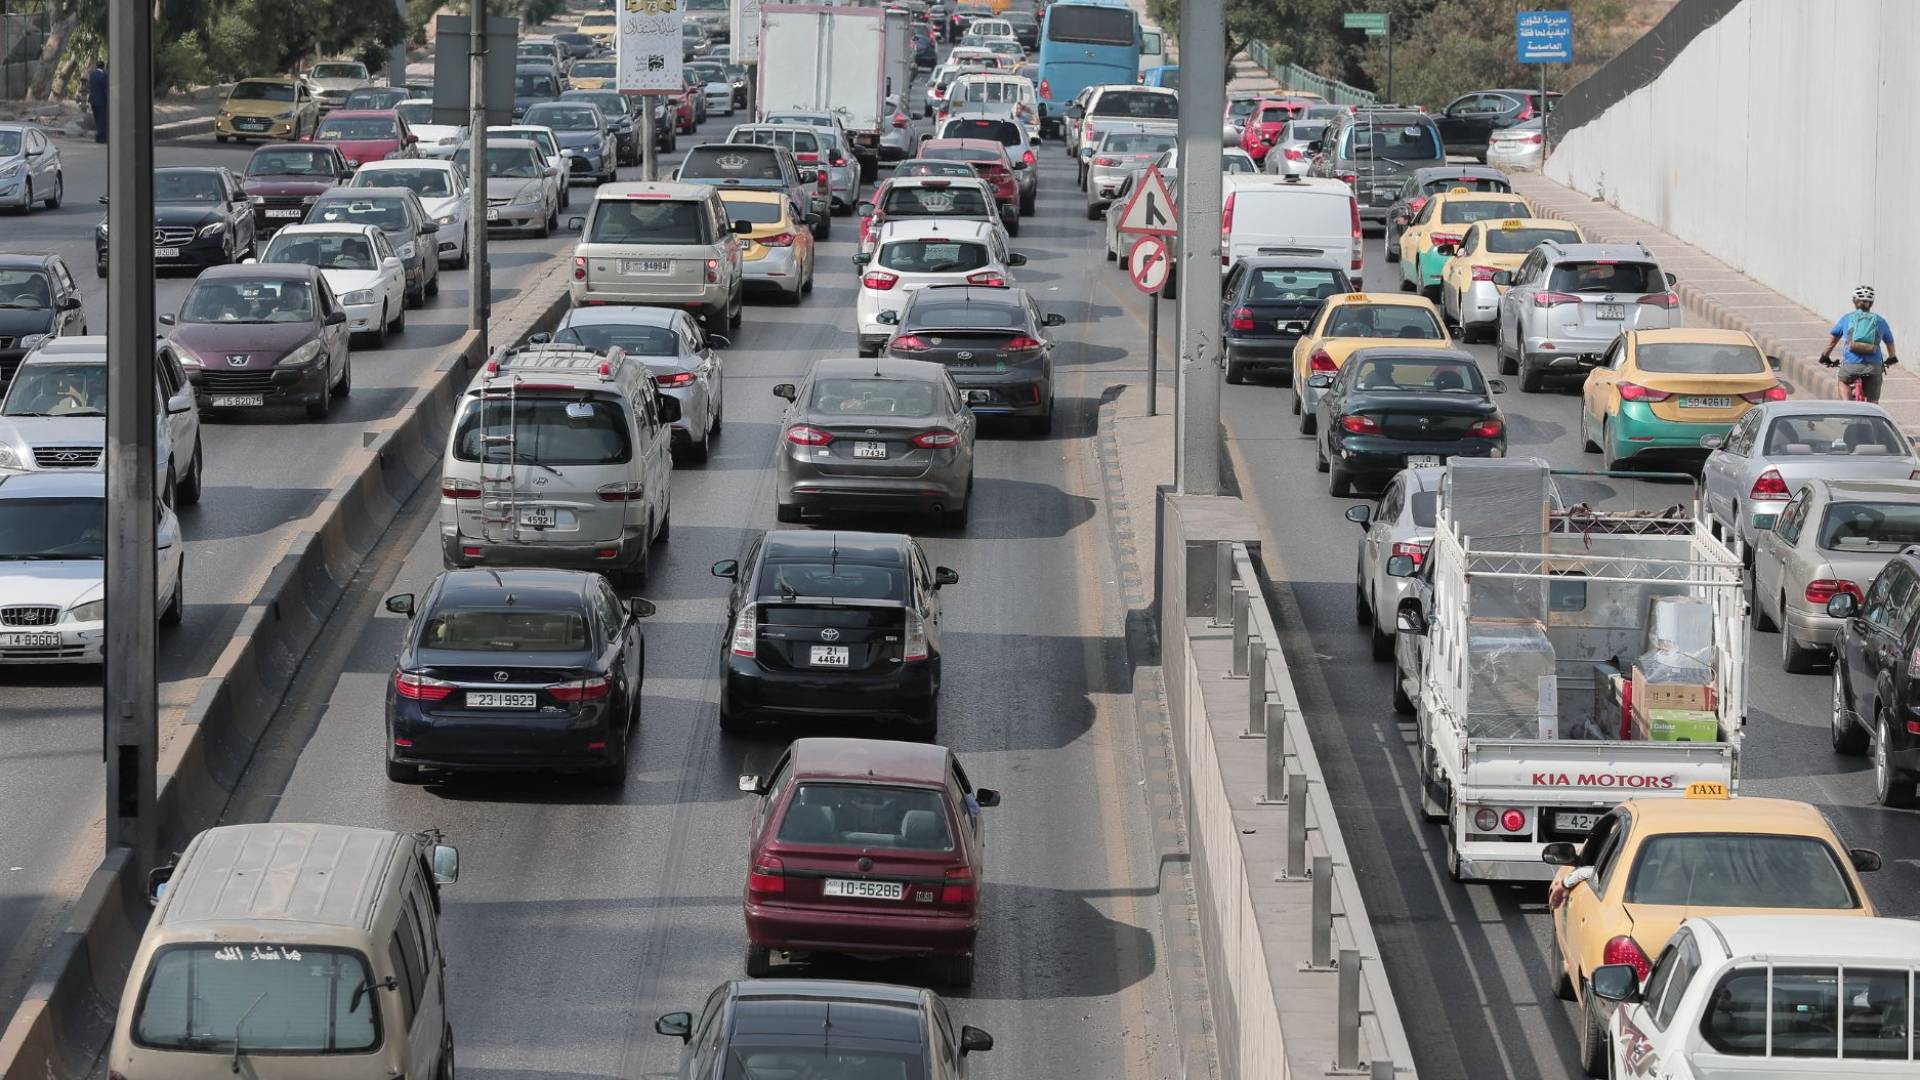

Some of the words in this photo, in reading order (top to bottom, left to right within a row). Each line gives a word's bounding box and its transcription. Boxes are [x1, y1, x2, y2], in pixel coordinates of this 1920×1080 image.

[535, 507, 546, 516] 40
[826, 647, 837, 655] 21
[817, 655, 846, 664] 44641
[479, 694, 535, 706] 23-19923
[1532, 773, 1570, 787] KIA
[1577, 773, 1674, 789] MOTORS
[1691, 784, 1723, 796] TAXI
[840, 881, 901, 898] 10-56286
[214, 945, 244, 961] الله
